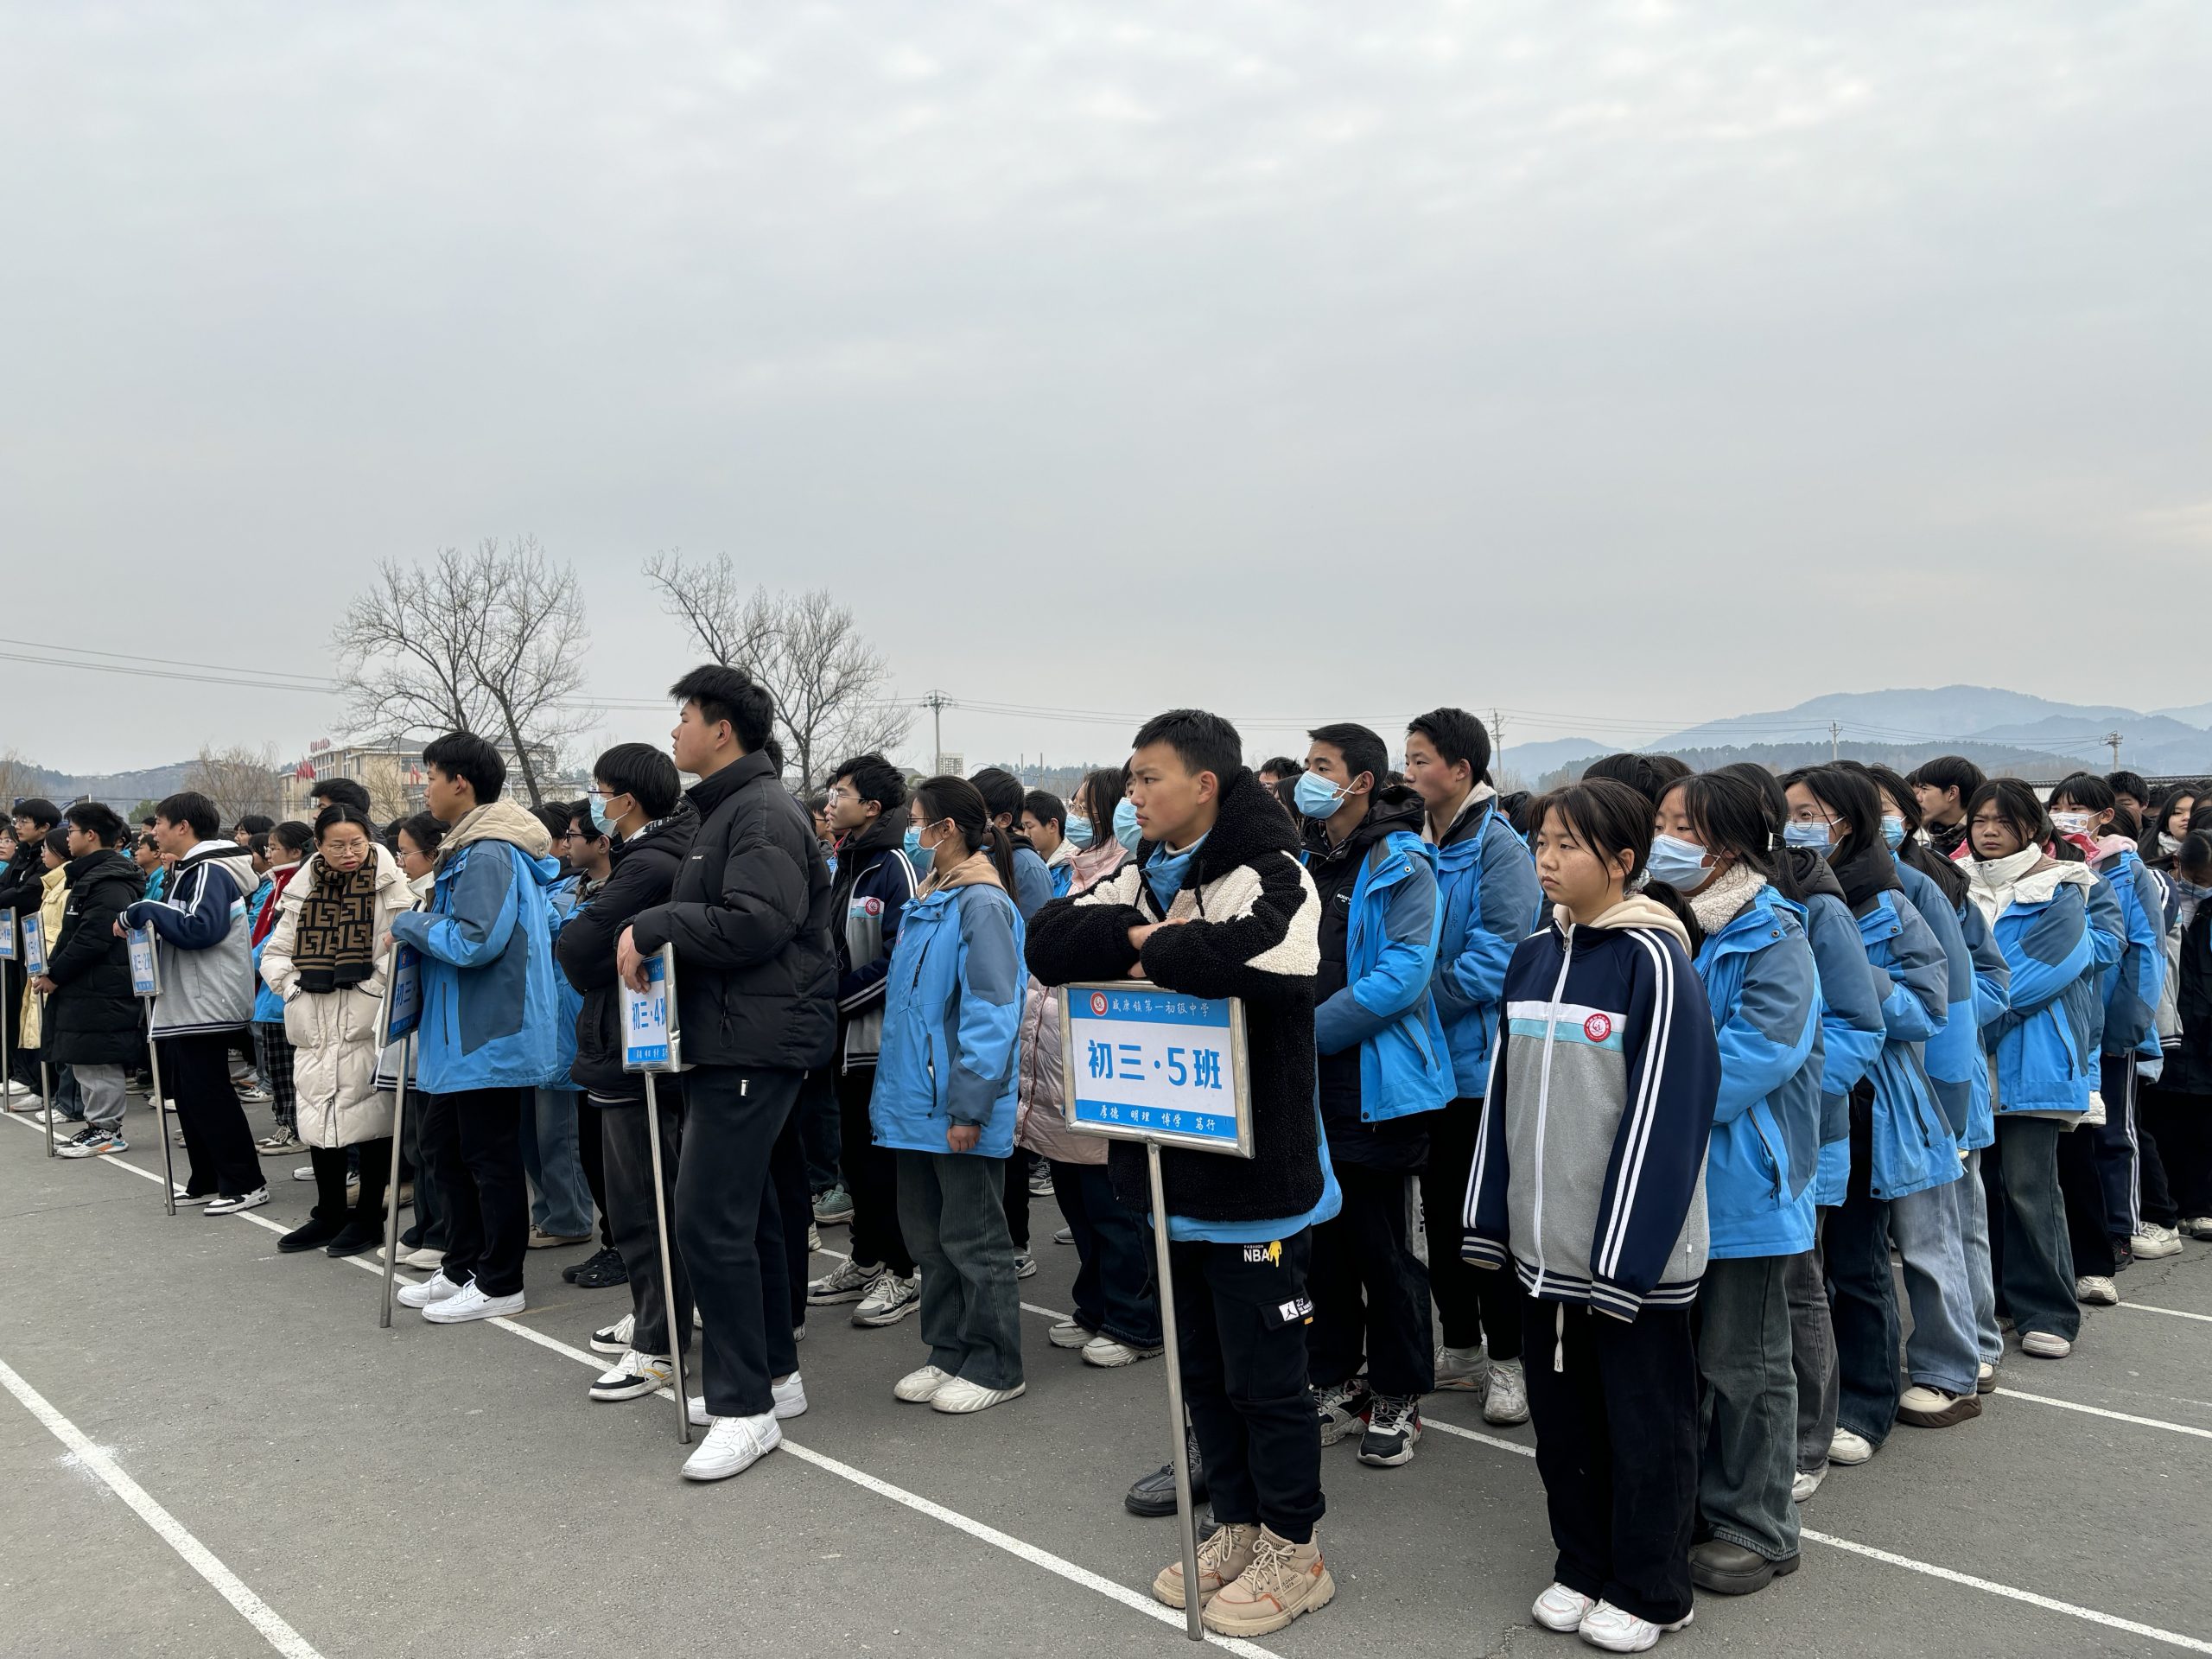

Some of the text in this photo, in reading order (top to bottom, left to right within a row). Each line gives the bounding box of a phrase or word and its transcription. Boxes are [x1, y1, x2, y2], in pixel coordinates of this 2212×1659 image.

[1088, 1039, 1222, 1090] 初三·5班
[1099, 1104, 1216, 1131] 厚德 明理 博学 笃行
[1243, 1249, 1270, 1262] NBA
[1296, 1298, 1304, 1307] 23
